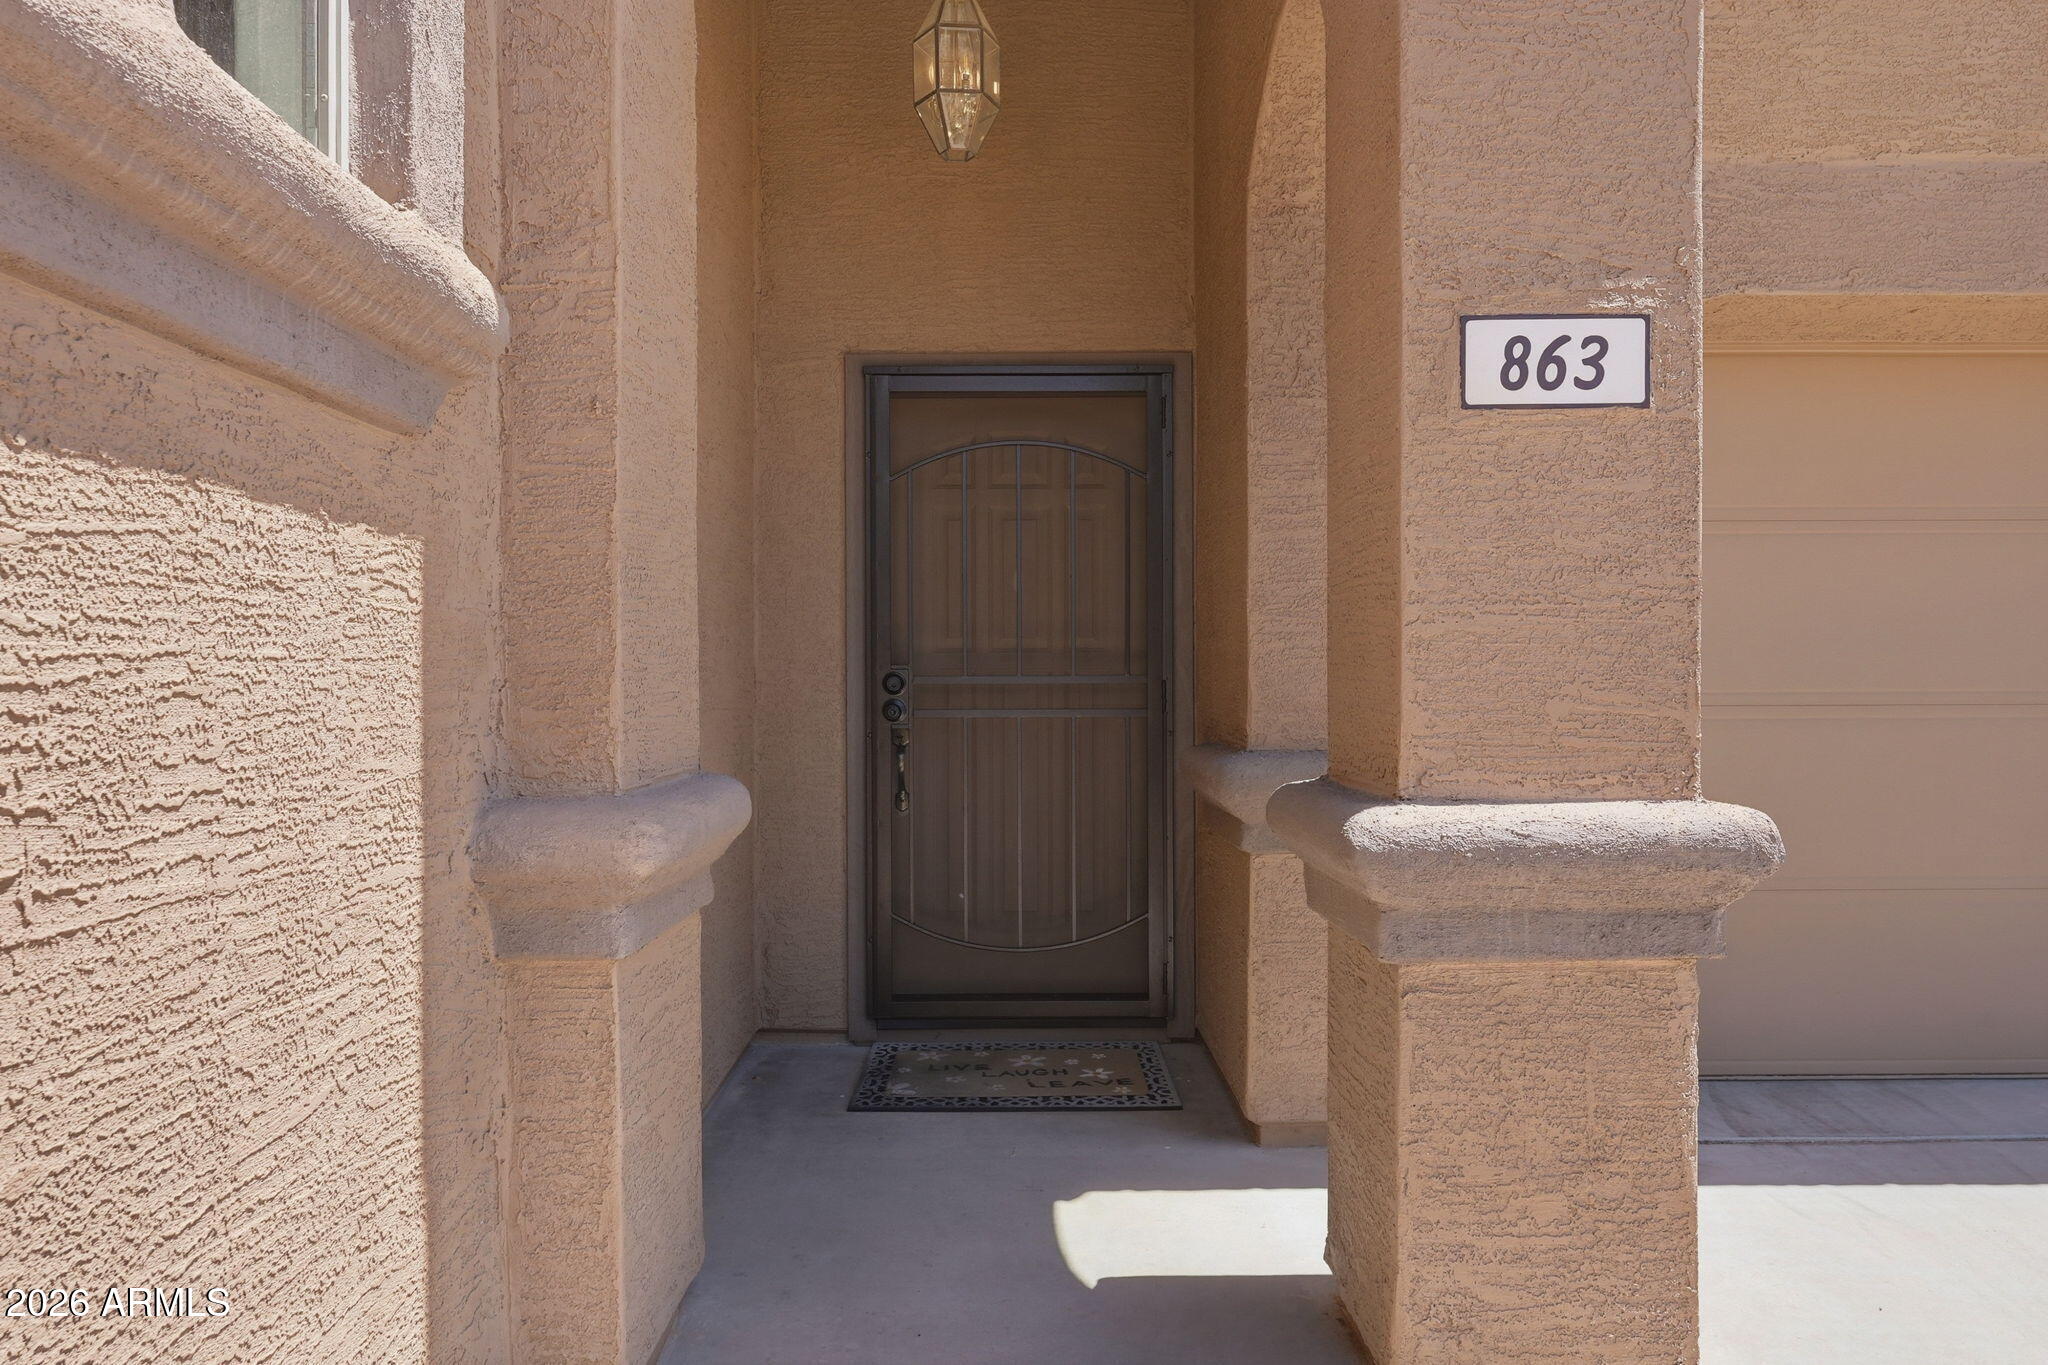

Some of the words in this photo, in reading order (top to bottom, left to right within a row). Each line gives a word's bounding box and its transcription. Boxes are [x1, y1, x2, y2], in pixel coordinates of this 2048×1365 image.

[1499, 334, 1609, 391] 863
[927, 1063, 992, 1072] LIVE
[981, 1067, 1069, 1078] LAUGH
[1026, 1077, 1134, 1088] LEAVE
